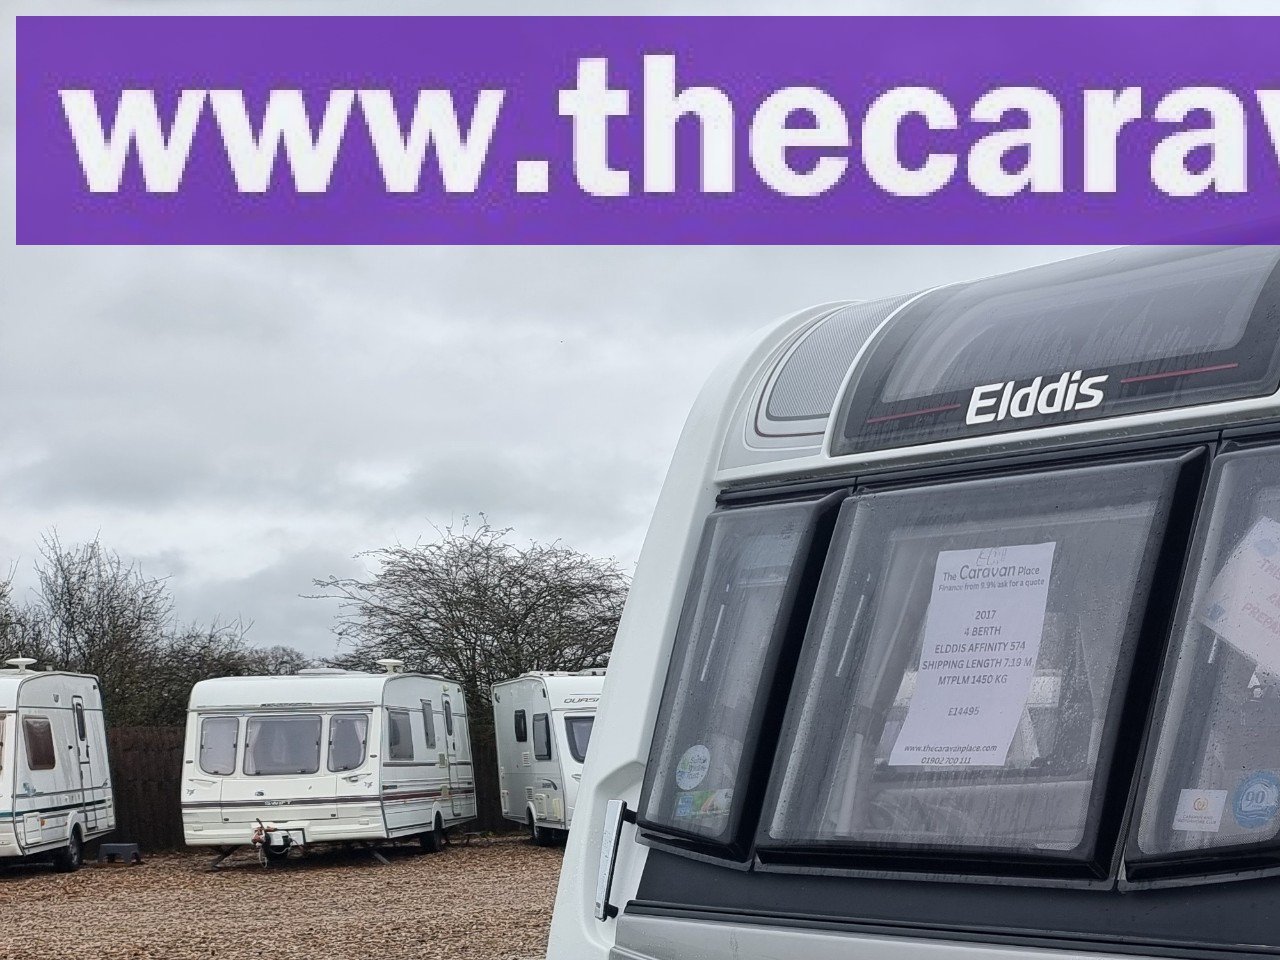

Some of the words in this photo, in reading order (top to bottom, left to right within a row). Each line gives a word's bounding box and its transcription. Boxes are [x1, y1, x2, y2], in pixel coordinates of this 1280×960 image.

[965, 369, 1109, 425] Elddis
[943, 572, 957, 581] The
[960, 564, 1016, 580] Caravan
[1018, 566, 1040, 576] Place
[1025, 579, 1045, 588] quote
[975, 610, 997, 620] 2017
[964, 627, 970, 636] 4
[971, 626, 1002, 637] BERTH
[934, 643, 966, 654] ELDDIS
[967, 642, 1009, 653] AFFINITY
[1010, 641, 1026, 651] 574
[922, 660, 964, 670] SHIPPING
[966, 659, 1002, 669] LENGTH
[937, 675, 970, 686] MTPLM
[971, 674, 994, 685] 1450
[994, 674, 1008, 684] KG
[904, 744, 997, 754] www.thecaravanplace.com
